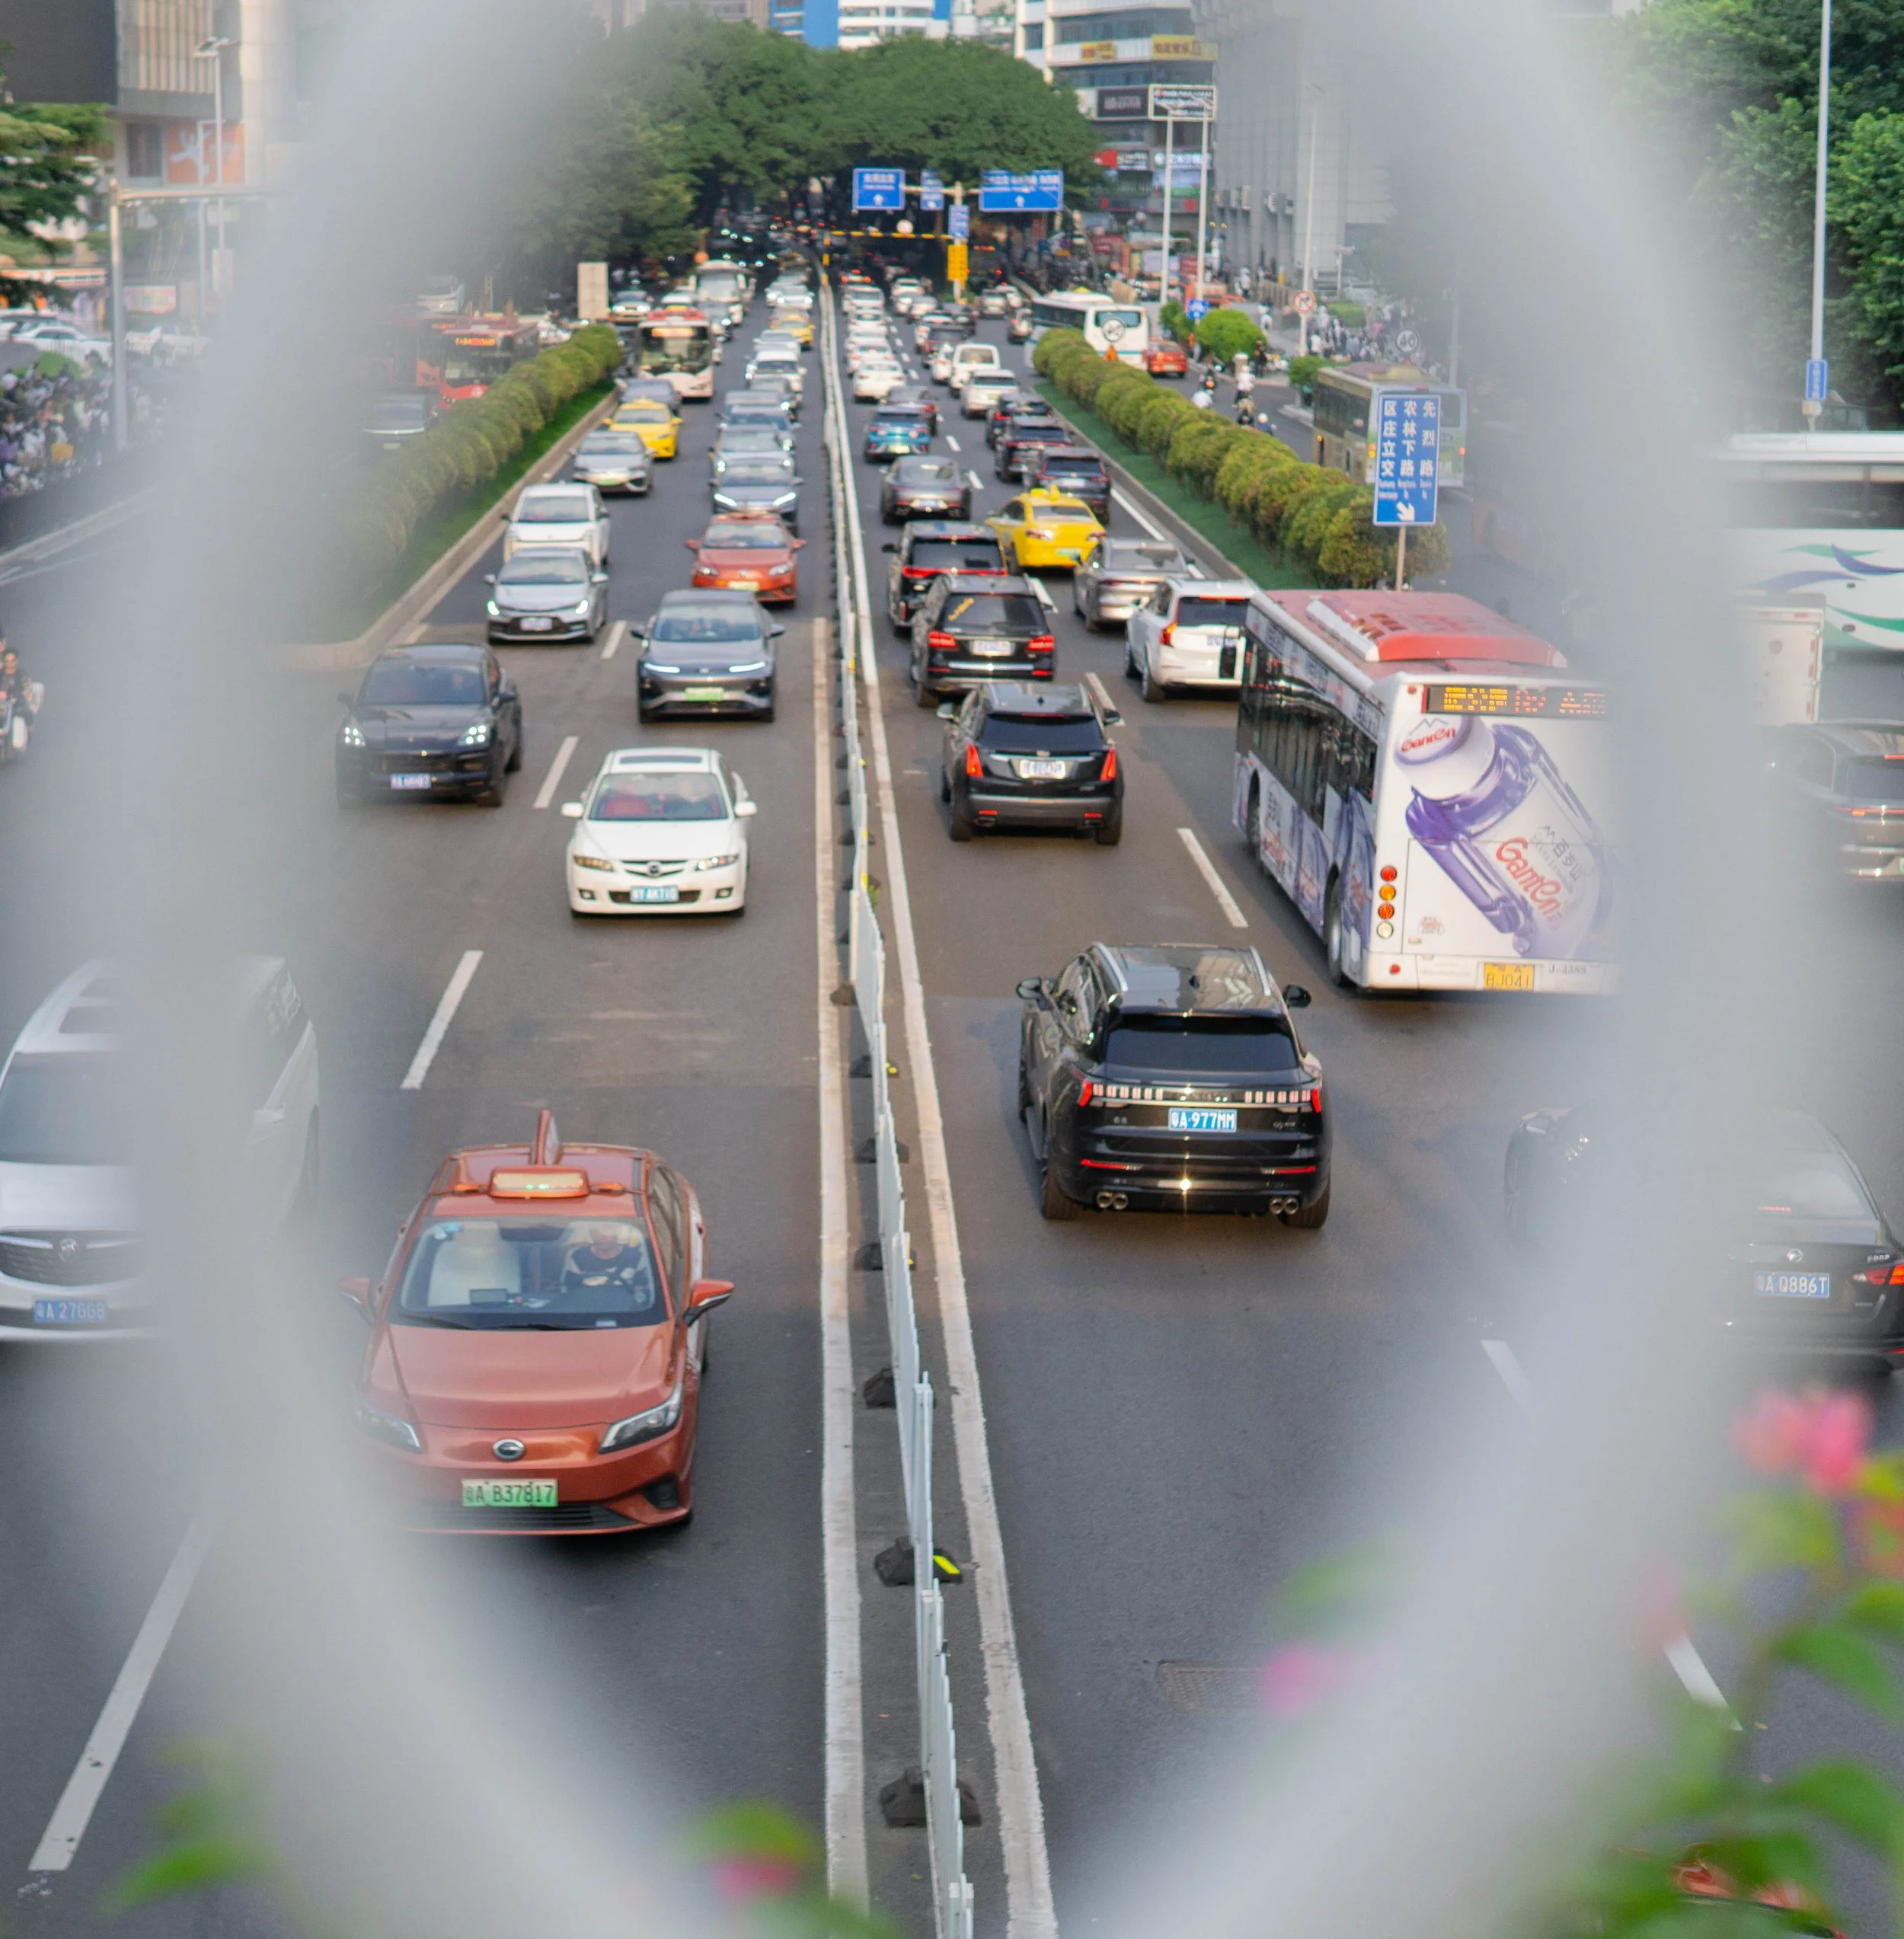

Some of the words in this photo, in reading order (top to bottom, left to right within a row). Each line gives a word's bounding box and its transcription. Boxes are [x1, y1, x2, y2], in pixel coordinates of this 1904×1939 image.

[1381, 400, 1397, 478] 区庄立交
[1400, 400, 1417, 478] 农林下路
[1420, 400, 1436, 478] 先烈路
